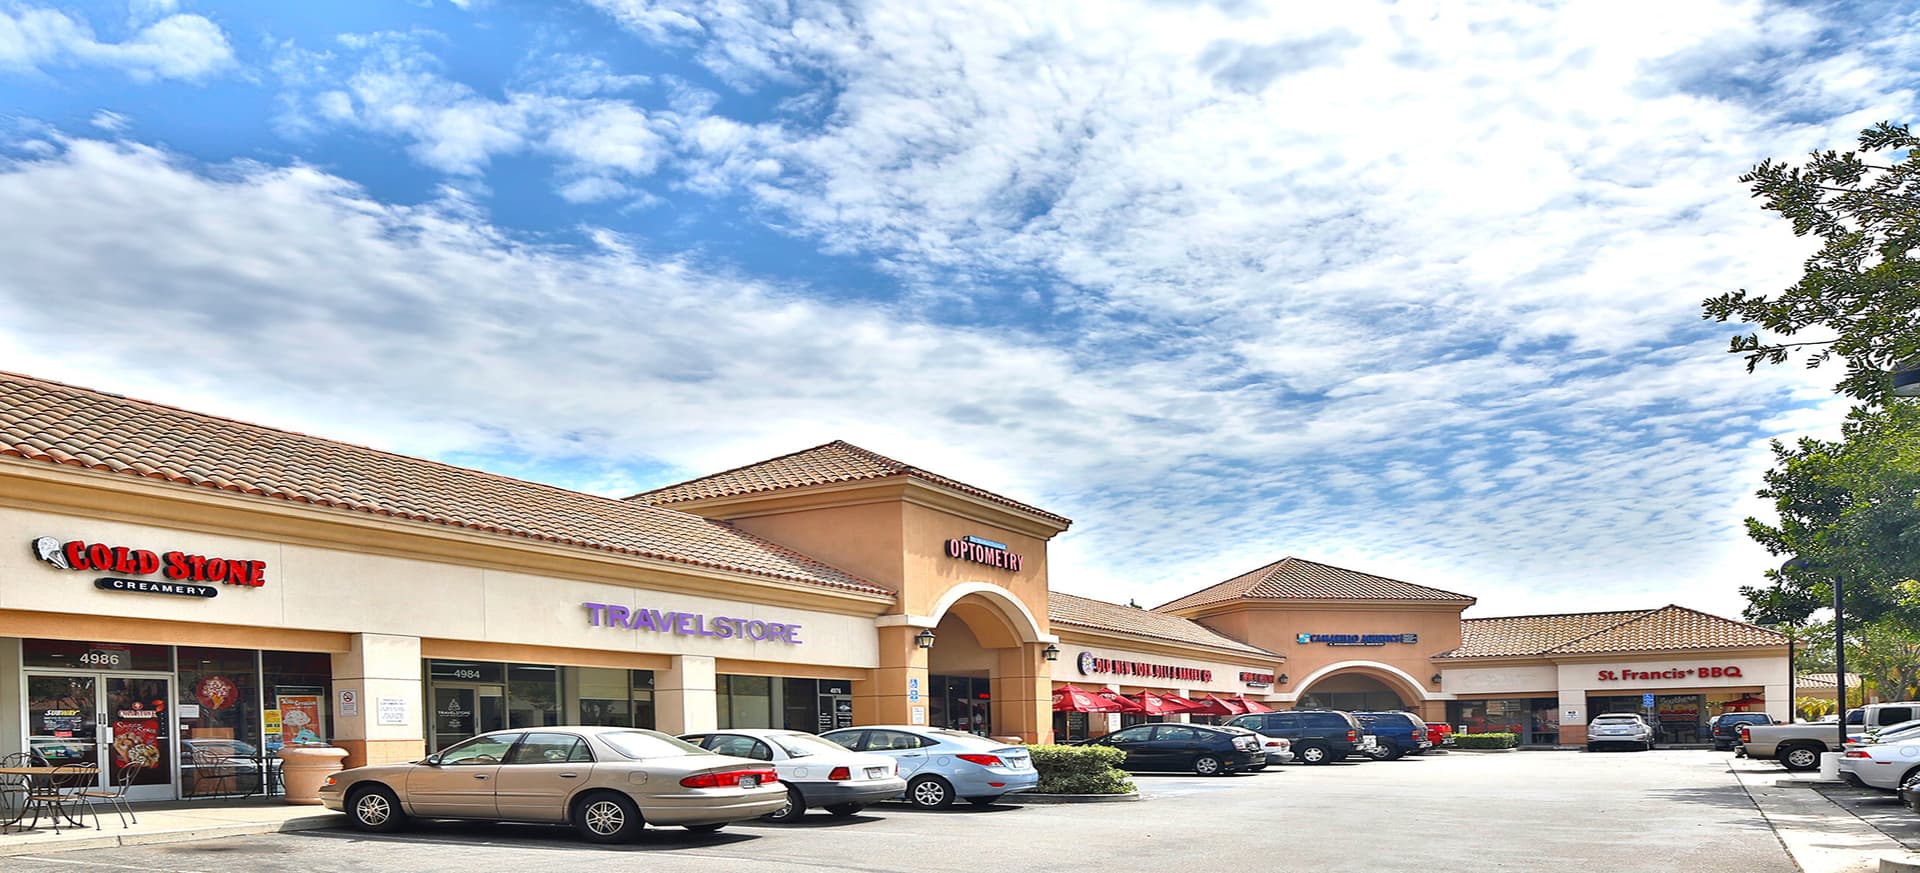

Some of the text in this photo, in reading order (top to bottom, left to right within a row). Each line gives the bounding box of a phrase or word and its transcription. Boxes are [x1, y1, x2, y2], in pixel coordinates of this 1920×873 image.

[948, 538, 1024, 571] OPTOMETRY
[65, 540, 266, 587] COLD STONE
[113, 580, 207, 596] CREAMERY
[583, 602, 803, 644] TRAVELSTORE
[80, 653, 119, 664] 4986
[454, 669, 480, 679] 4984
[1598, 670, 1618, 680] St.
[1698, 666, 1743, 678] BBQ
